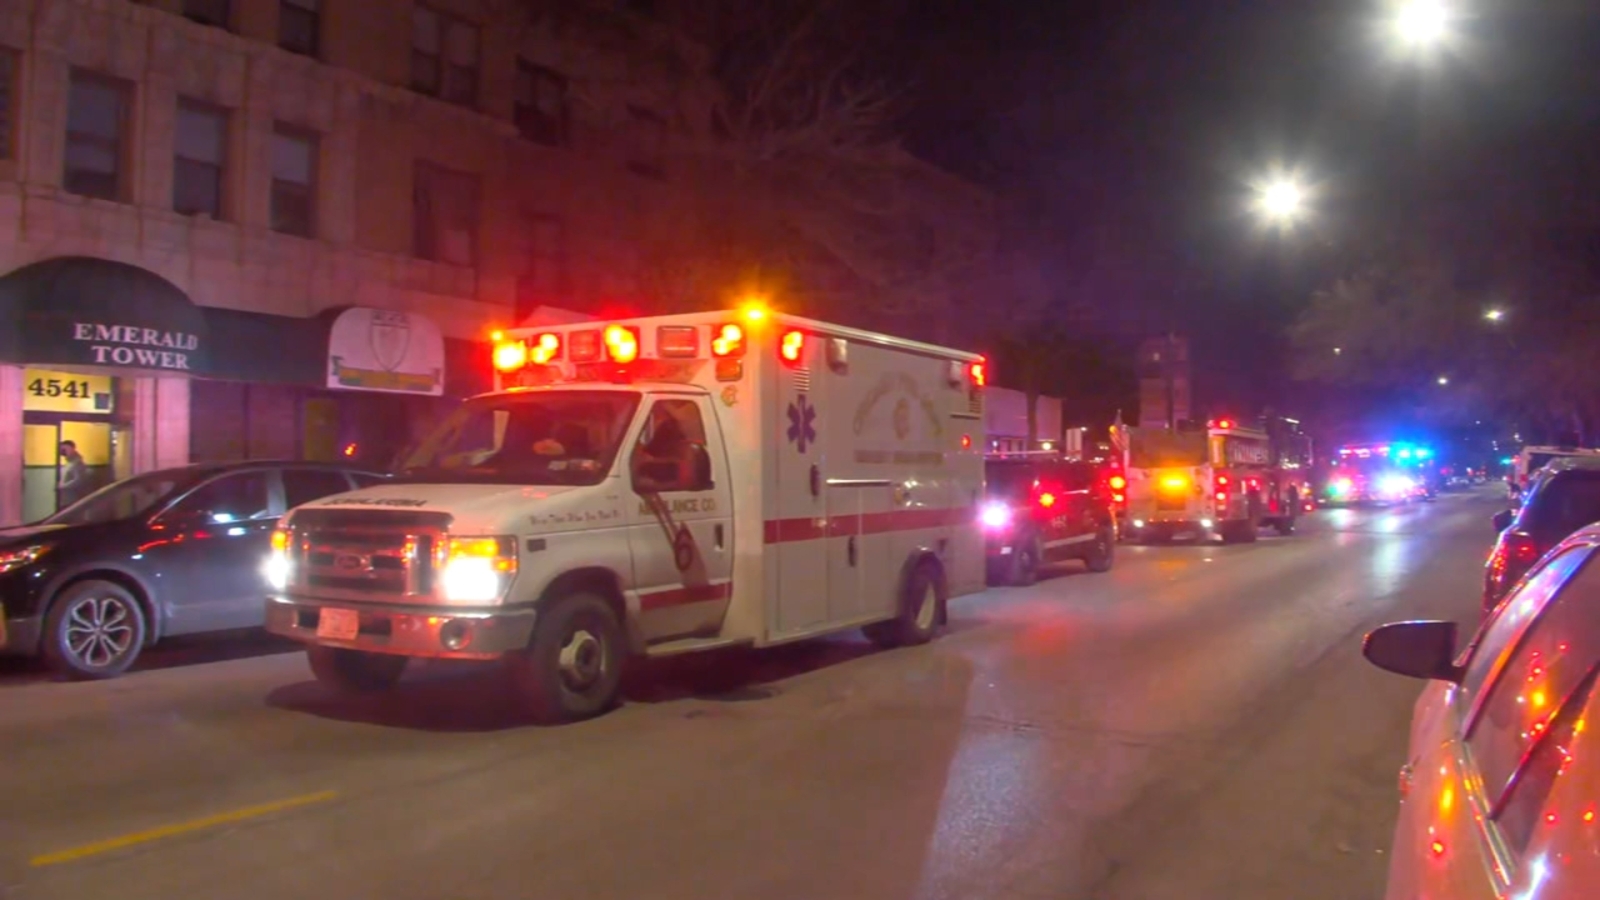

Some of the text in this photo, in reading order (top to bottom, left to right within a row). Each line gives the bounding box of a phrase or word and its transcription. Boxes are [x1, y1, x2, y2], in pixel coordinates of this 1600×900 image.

[73, 323, 198, 350] EMERALD
[91, 345, 190, 370] TOWER
[28, 378, 91, 398] 4541
[639, 499, 699, 515] AULANCE
